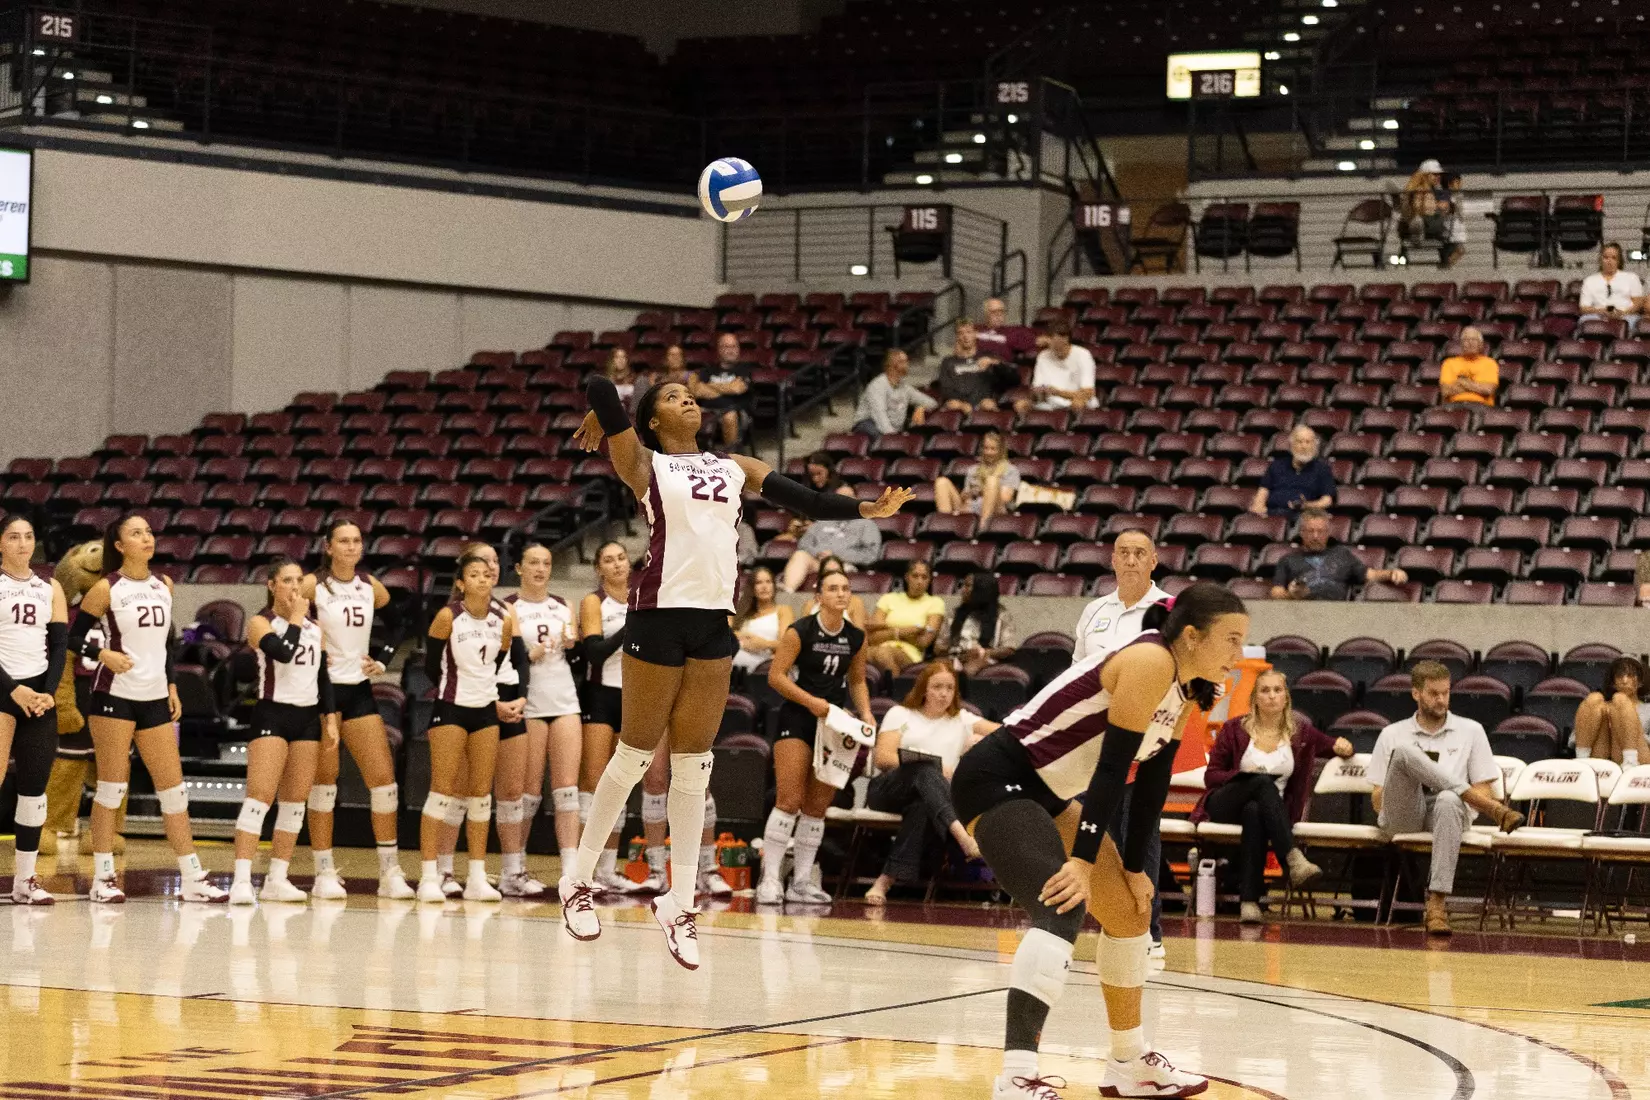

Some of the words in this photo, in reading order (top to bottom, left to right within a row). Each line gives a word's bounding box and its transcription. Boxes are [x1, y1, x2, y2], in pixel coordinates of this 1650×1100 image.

[41, 15, 73, 38] 215
[998, 82, 1029, 103] 215
[1200, 73, 1232, 94] 216
[911, 208, 938, 230] 115
[1084, 205, 1111, 227] 116
[687, 475, 729, 503] 22
[11, 603, 36, 625] 18
[137, 605, 165, 628] 20
[343, 606, 364, 627] 15
[295, 644, 315, 666] 21
[479, 645, 487, 665] 1
[823, 654, 840, 676] 11
